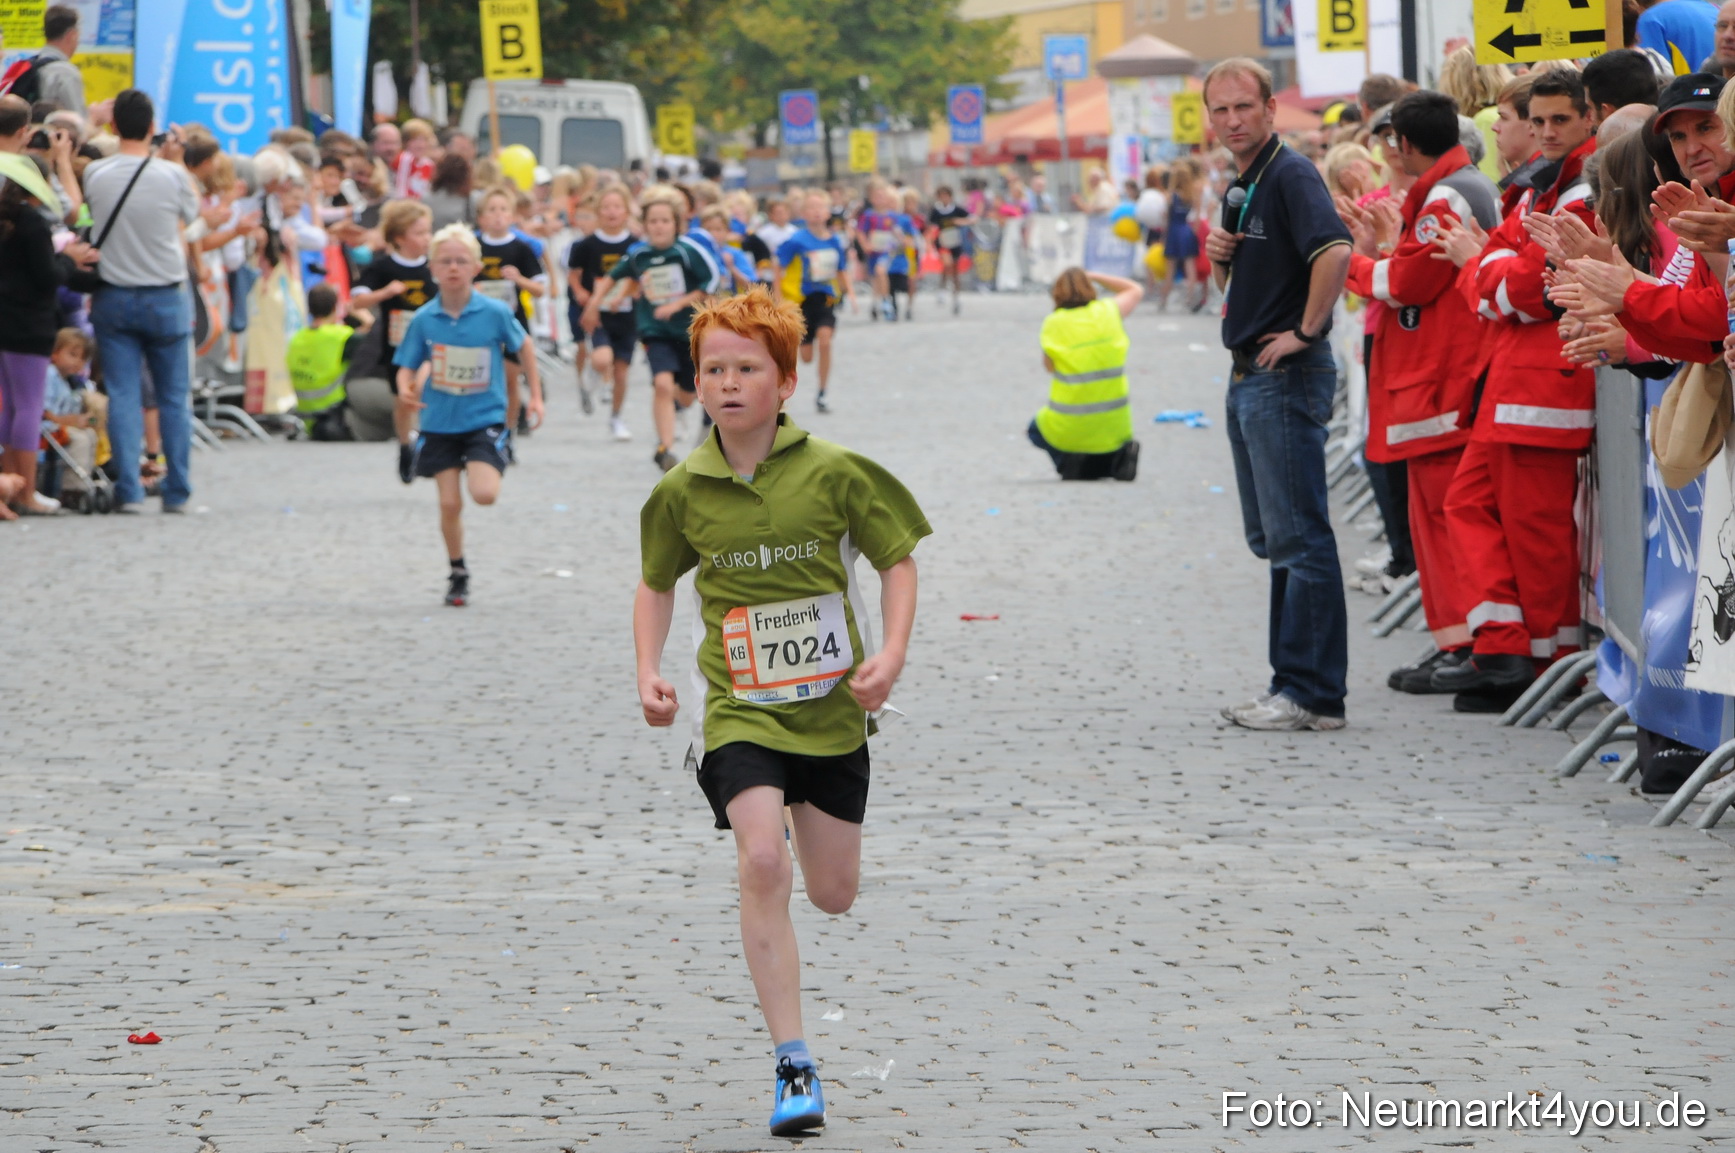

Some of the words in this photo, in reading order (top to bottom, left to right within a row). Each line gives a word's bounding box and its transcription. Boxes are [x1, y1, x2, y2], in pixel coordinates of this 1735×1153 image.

[1331, 0, 1356, 33] B
[500, 24, 525, 60] B
[1178, 105, 1195, 131] C
[664, 120, 686, 147] C
[712, 550, 757, 568] EURO
[774, 538, 820, 563] POLES
[754, 603, 822, 632] Frederik
[730, 645, 747, 661] K6
[761, 631, 842, 670] 7024
